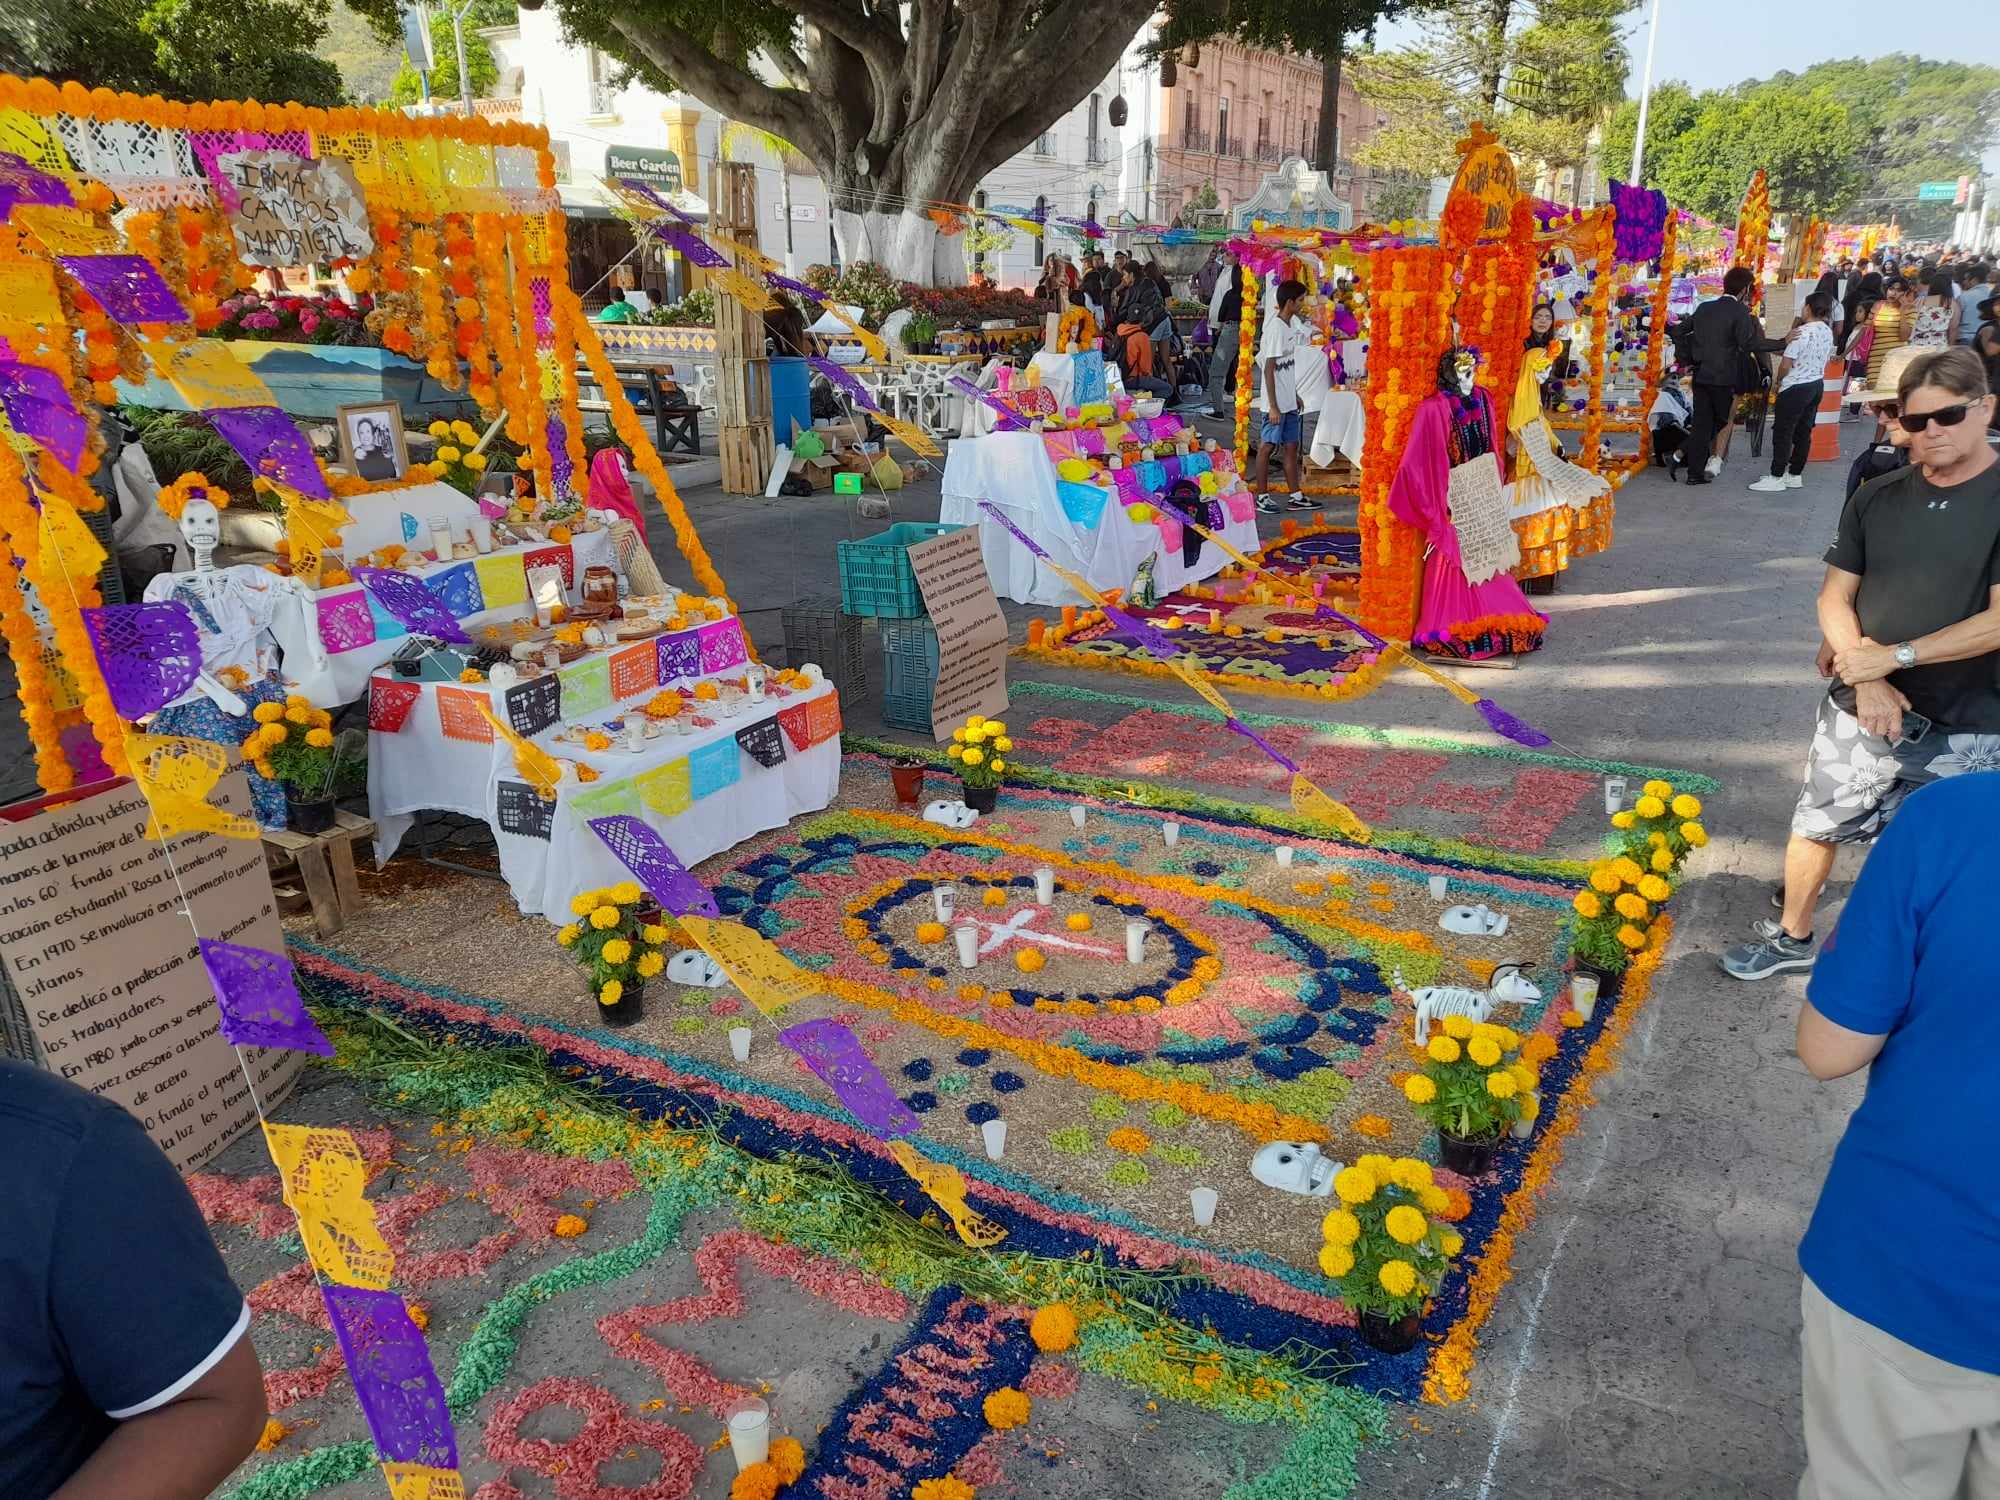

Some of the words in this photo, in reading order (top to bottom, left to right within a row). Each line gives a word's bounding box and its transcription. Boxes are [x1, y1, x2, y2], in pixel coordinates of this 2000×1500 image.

[234, 163, 307, 198] IRMA
[609, 155, 639, 170] Beer
[639, 158, 680, 174] Garden
[240, 197, 339, 225] CAMPOS
[242, 224, 353, 256] MADRIGAL
[38, 812, 96, 845] activista
[106, 797, 149, 820] defens
[42, 857, 61, 874] de
[62, 853, 79, 869] la
[79, 838, 118, 862] mujer
[118, 831, 136, 848] de
[120, 856, 144, 873] con
[14, 953, 41, 973] En
[42, 938, 77, 961] 1970
[79, 928, 99, 946] se
[156, 900, 173, 914] en
[36, 1009, 60, 1029] Se
[111, 985, 123, 997] a
[42, 1036, 68, 1055] los
[70, 993, 167, 1043] trabajadores
[59, 1061, 84, 1080] En
[83, 1046, 115, 1069] 1980
[148, 1022, 170, 1039] con
[170, 1015, 183, 1028] su
[132, 1090, 150, 1107] de
[154, 1069, 188, 1095] acero
[174, 1124, 195, 1144] luz
[199, 1109, 219, 1127] los
[186, 1137, 219, 1167] mujer
